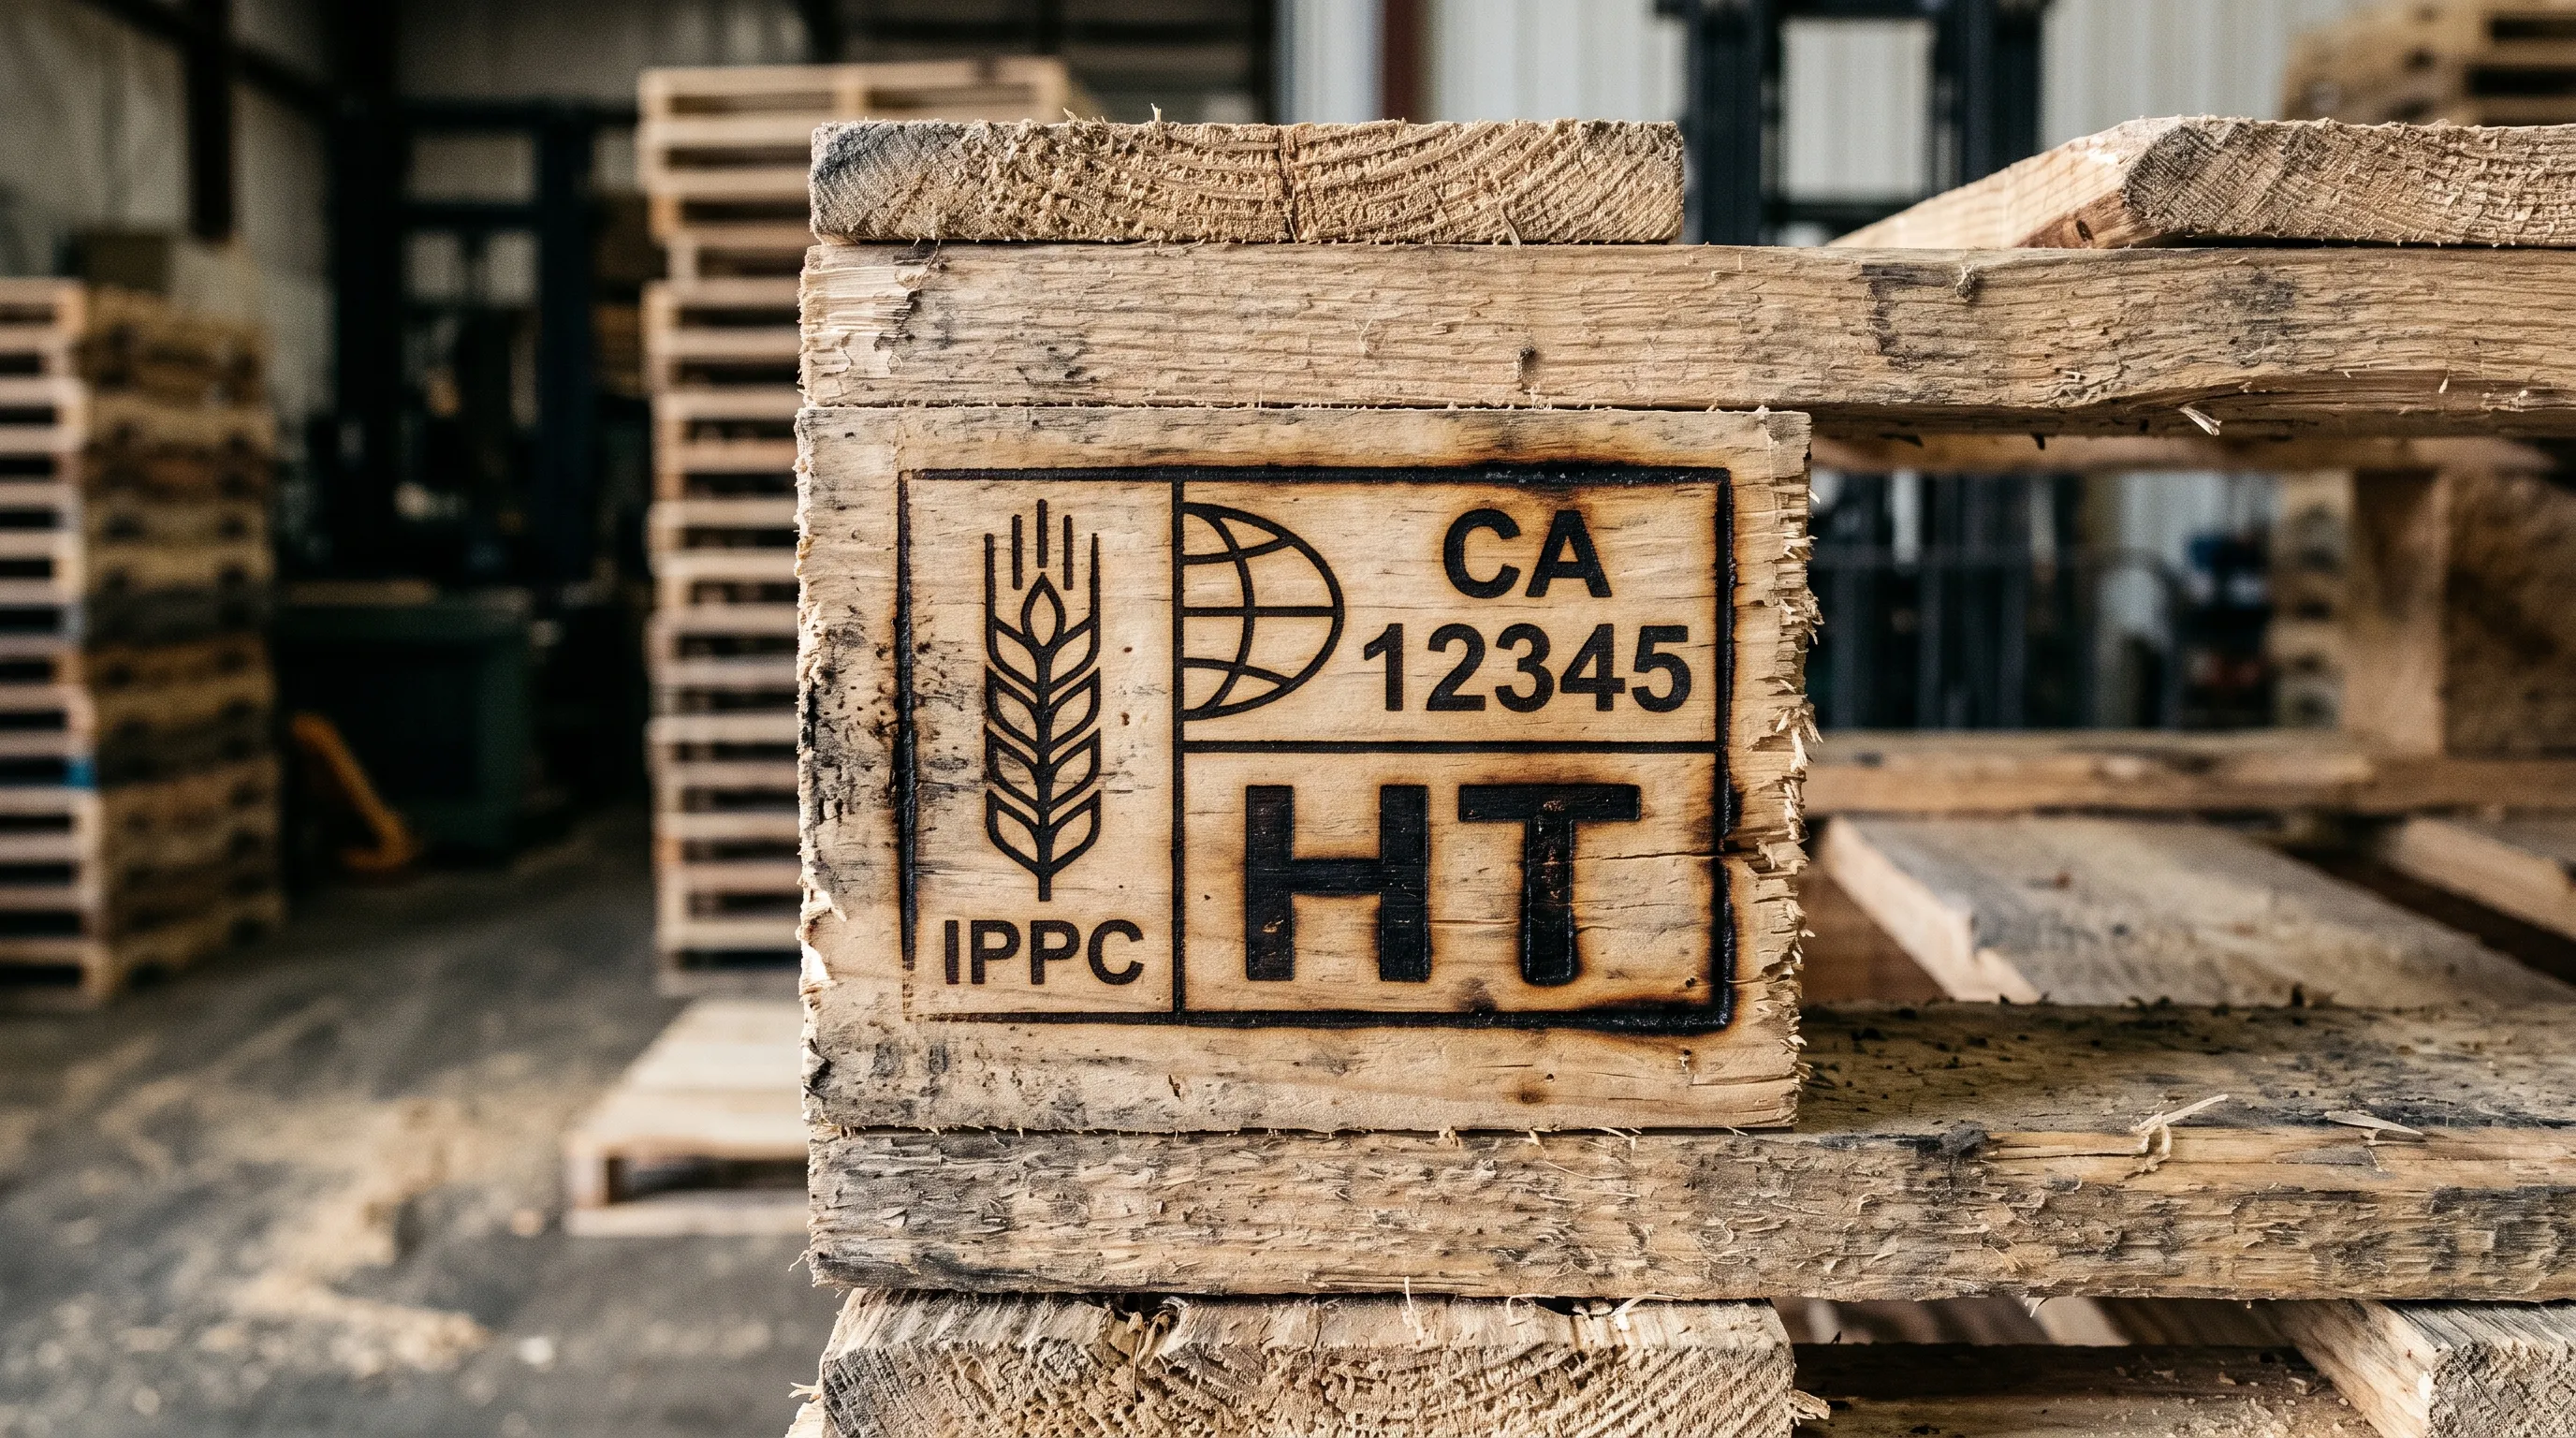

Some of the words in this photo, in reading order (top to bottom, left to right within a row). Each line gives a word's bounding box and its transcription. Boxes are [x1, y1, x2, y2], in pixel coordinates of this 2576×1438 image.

[1442, 506, 1613, 599] CA
[1363, 623, 1691, 713] 12345
[1243, 782, 1642, 986] HT
[944, 918, 1145, 986] IPPC
